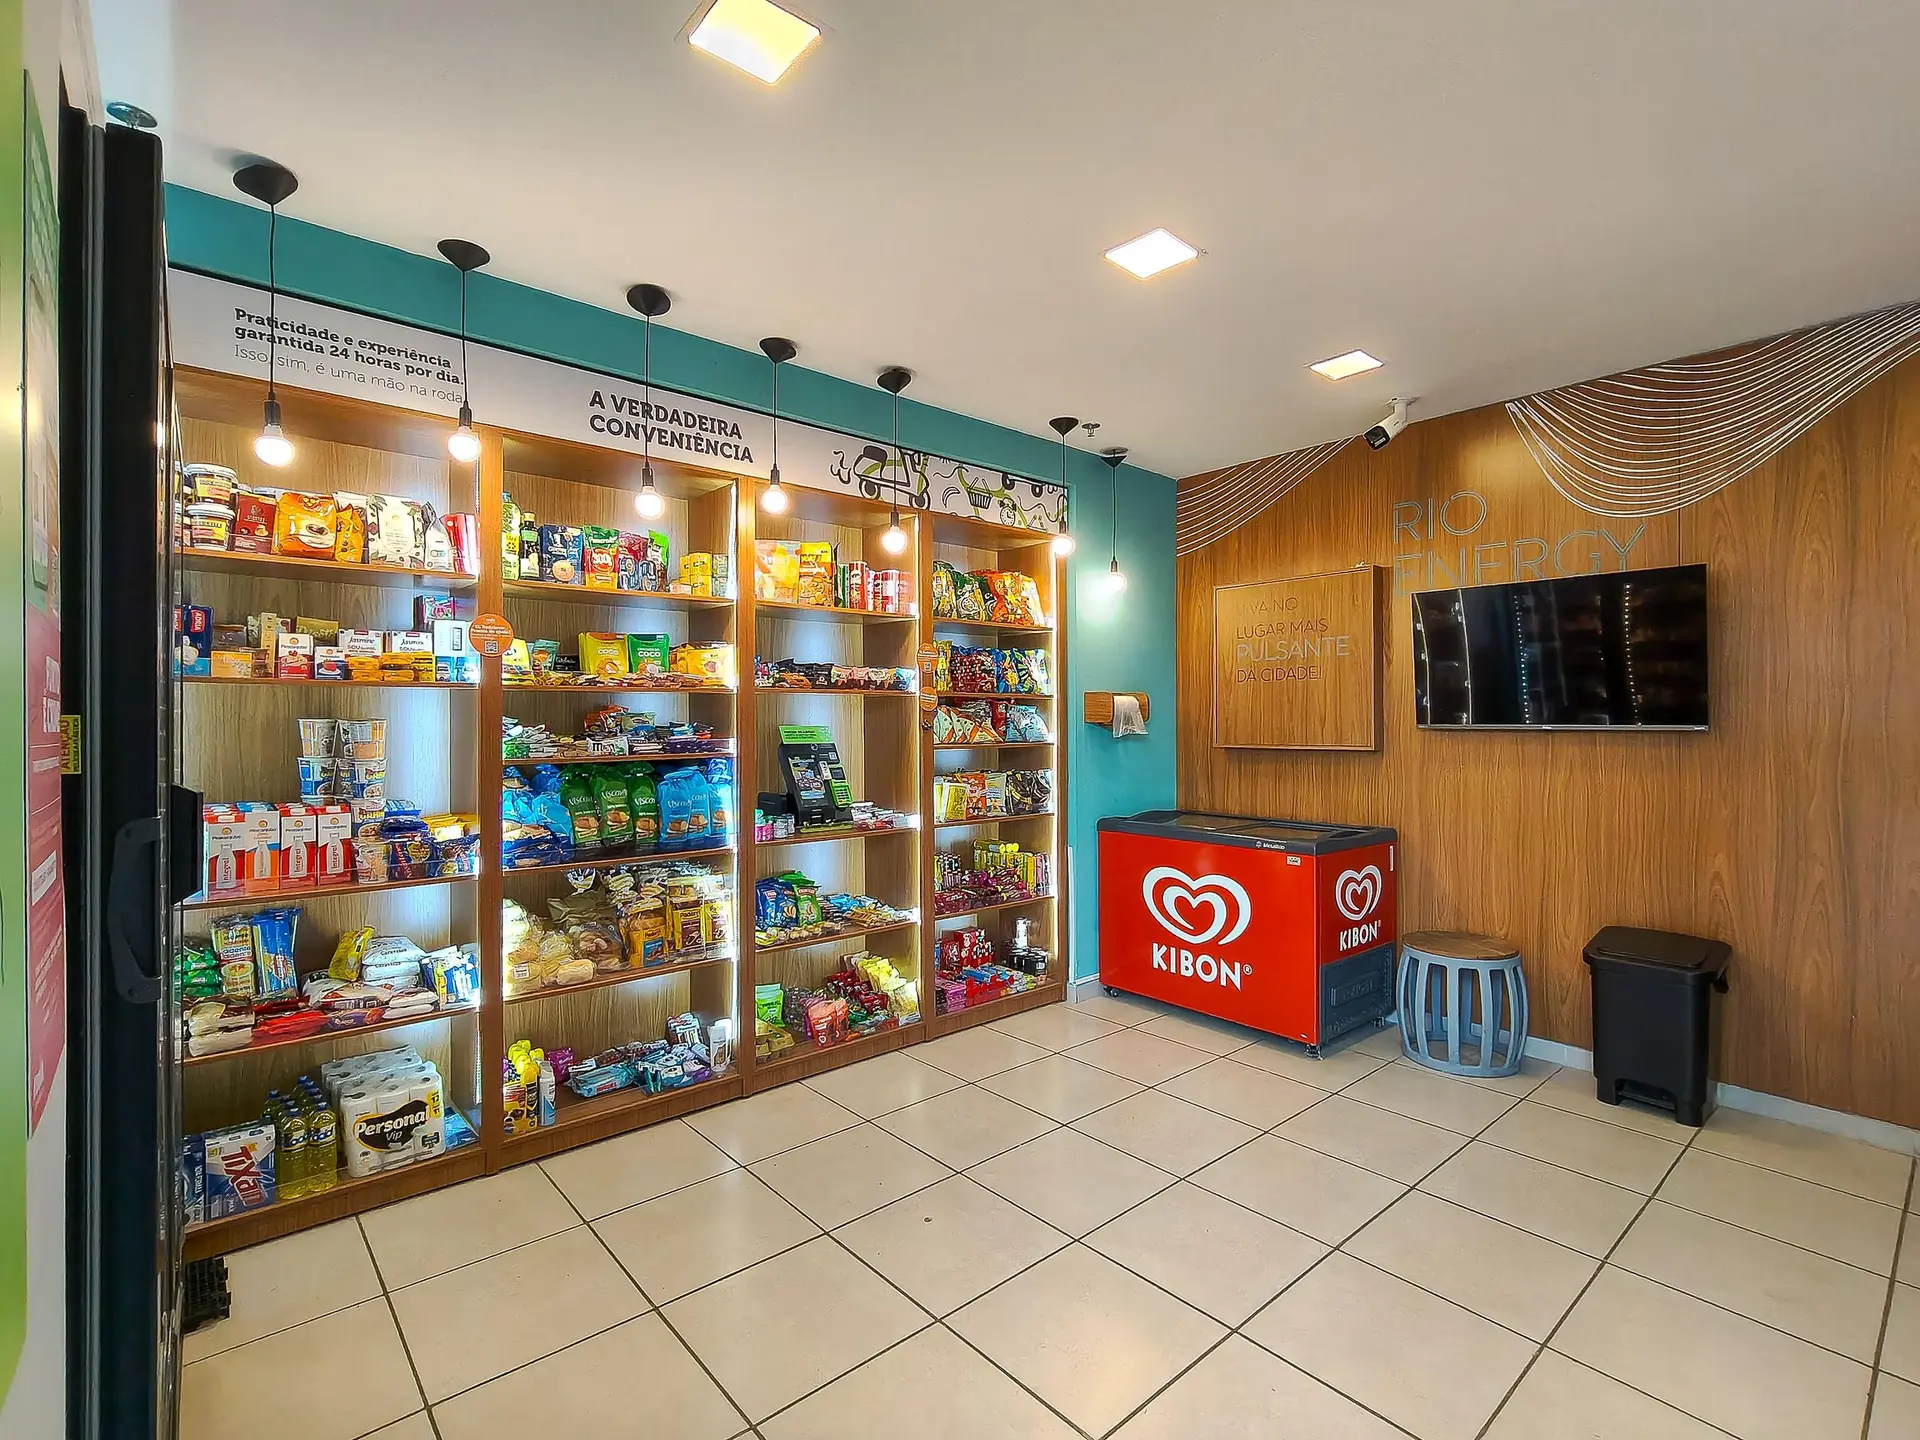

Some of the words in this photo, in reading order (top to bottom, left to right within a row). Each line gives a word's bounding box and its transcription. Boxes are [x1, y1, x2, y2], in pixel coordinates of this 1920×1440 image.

[233, 324, 326, 355] garantida
[328, 344, 352, 360] 24
[354, 350, 402, 373] horas
[404, 362, 433, 380] por
[435, 368, 465, 387] dia.
[234, 307, 340, 344] Praticidade
[344, 334, 354, 346] e
[357, 338, 453, 370] experiência
[276, 356, 311, 374] sim,
[315, 361, 326, 375] é
[330, 367, 367, 385] uma
[370, 374, 406, 392] mão
[409, 382, 428, 397] na
[588, 390, 607, 410] A
[610, 393, 743, 440] VERDADEIRA
[589, 413, 754, 464] CONVENIÊNCIA
[1392, 488, 1488, 544] RIO
[1392, 520, 1649, 597] ENERGY
[1236, 622, 1286, 640] LUGAR
[1290, 617, 1329, 635] MAIS
[1272, 596, 1300, 612] NO
[1236, 635, 1351, 663] PULSANTE
[1237, 668, 1257, 683] DA
[1260, 665, 1323, 682] CIDADE!
[60, 719, 72, 771] ATENÇÃO
[354, 1104, 431, 1137] Personal
